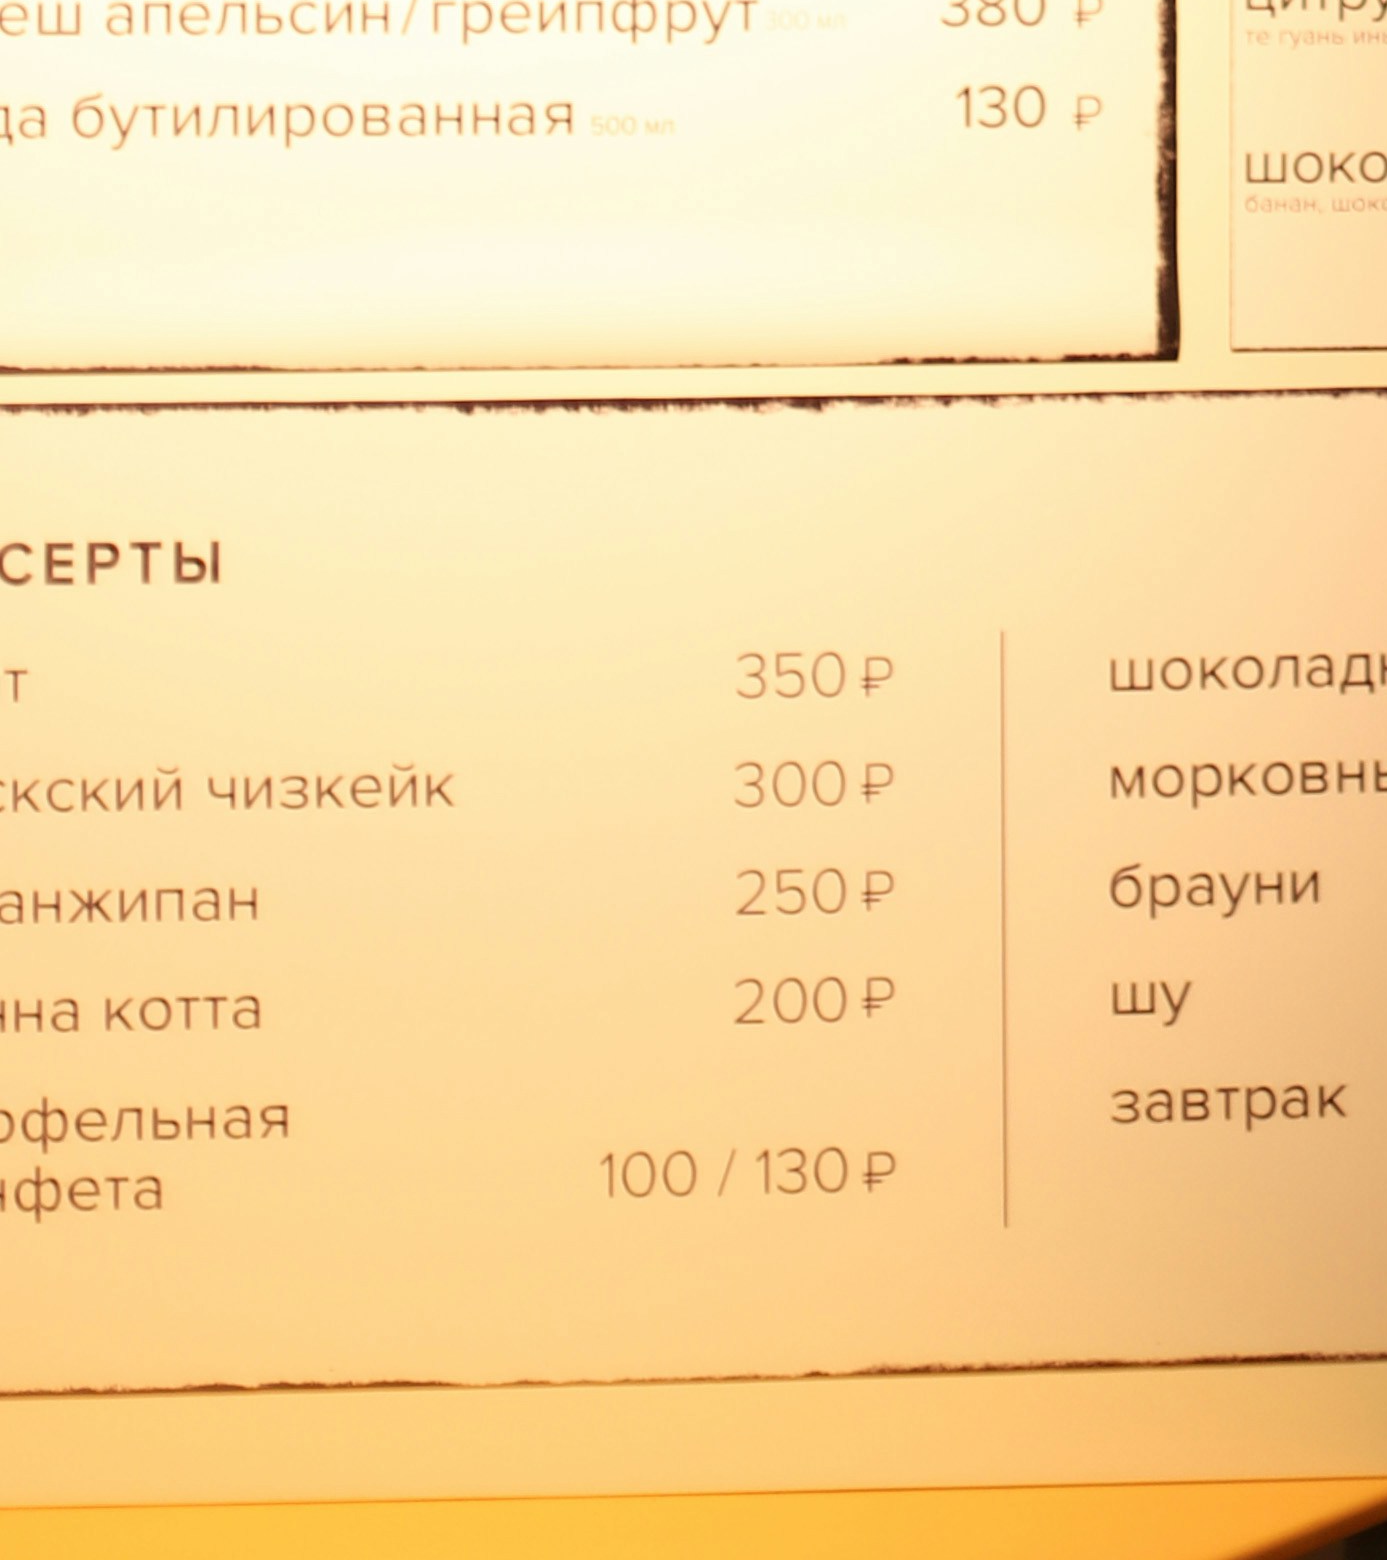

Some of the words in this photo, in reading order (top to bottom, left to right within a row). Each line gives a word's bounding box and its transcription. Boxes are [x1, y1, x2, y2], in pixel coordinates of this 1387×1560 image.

[71, 91, 574, 152] бутилированная
[589, 113, 639, 137] 500
[643, 118, 677, 137] мл
[955, 83, 1047, 129] 130
[0, 540, 220, 587] СЕРТЫ
[207, 763, 454, 810] чизкейк
[0, 886, 258, 925] анжипан
[1109, 862, 1320, 920] брауни
[0, 997, 80, 1033] на
[104, 994, 261, 1032] котта
[1111, 980, 1193, 1028] шу
[1111, 1084, 1347, 1133] завтрак
[0, 1165, 163, 1224] фета
[599, 1149, 698, 1199] 100
